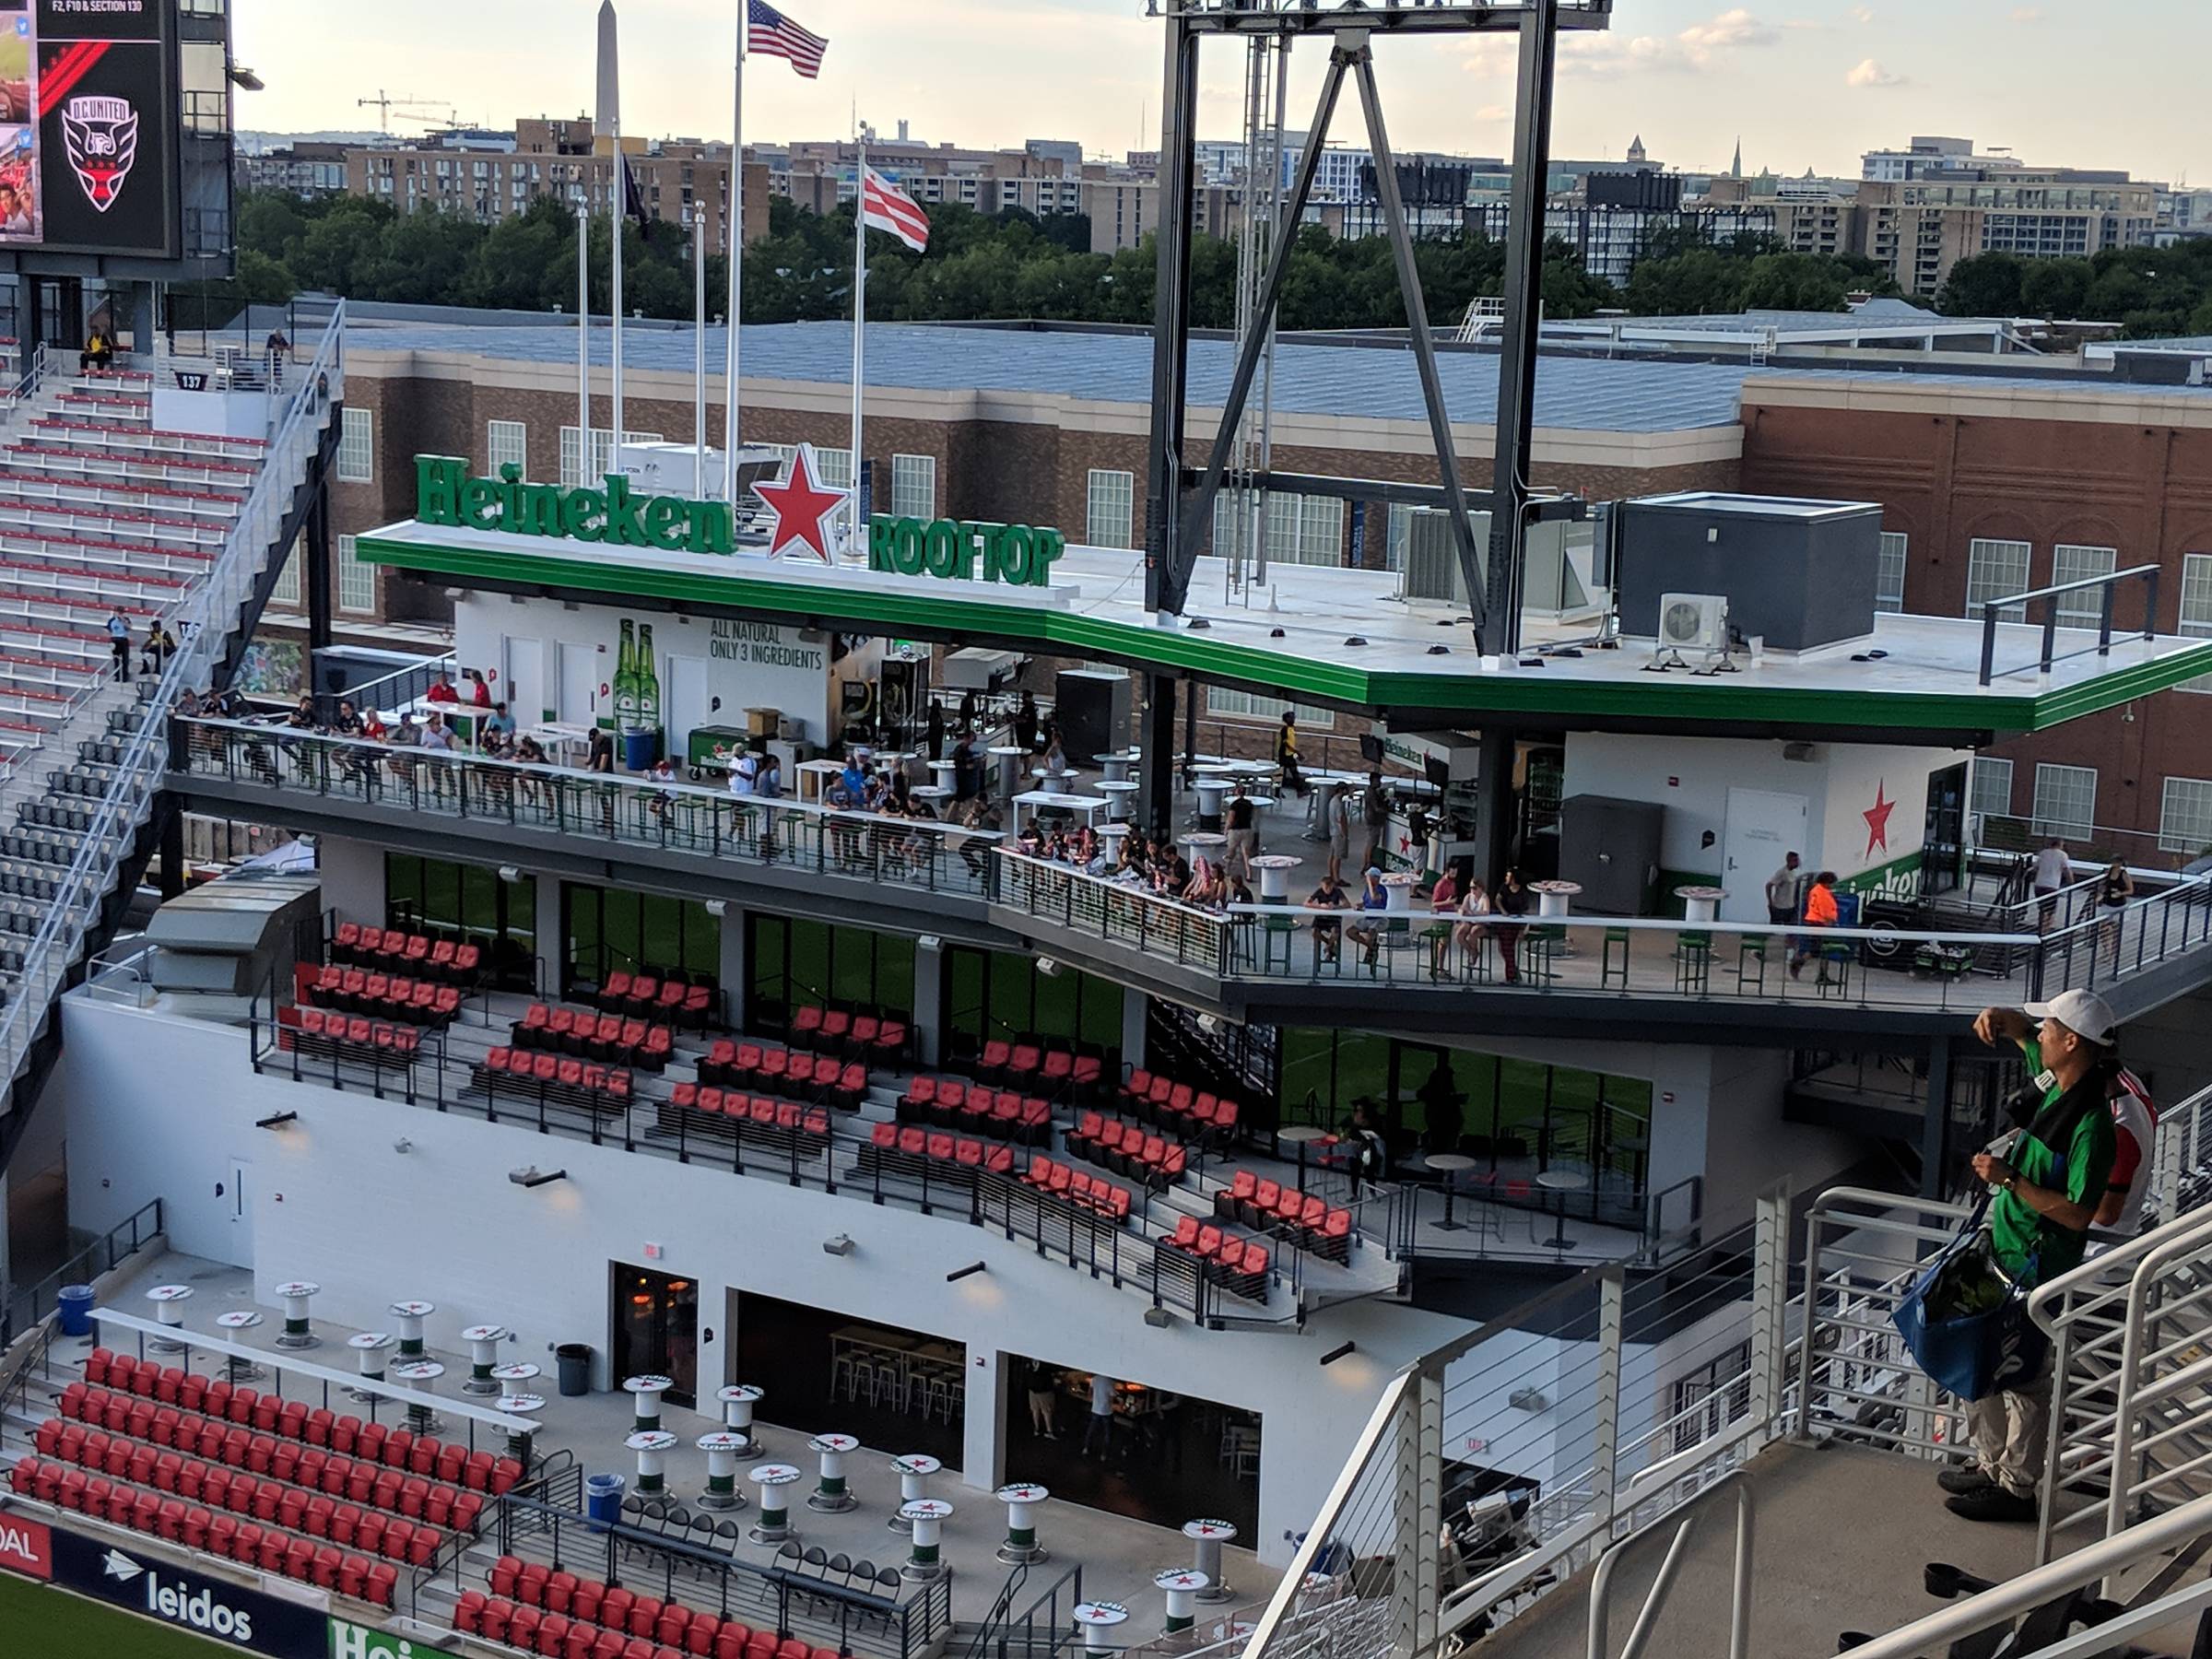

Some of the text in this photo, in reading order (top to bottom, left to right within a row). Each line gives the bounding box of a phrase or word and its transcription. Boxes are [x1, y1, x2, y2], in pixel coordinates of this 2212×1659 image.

[82, 0, 89, 12] &
[90, 0, 126, 12] SECTION
[90, 100, 126, 121] UNITED
[183, 375, 201, 388] 137
[415, 454, 1065, 588] Heineken ROOFTOP
[711, 619, 782, 645] ALL NATURAL
[711, 640, 823, 671] ONLY 3 INGREDIENTS
[148, 1571, 253, 1641] leidos
